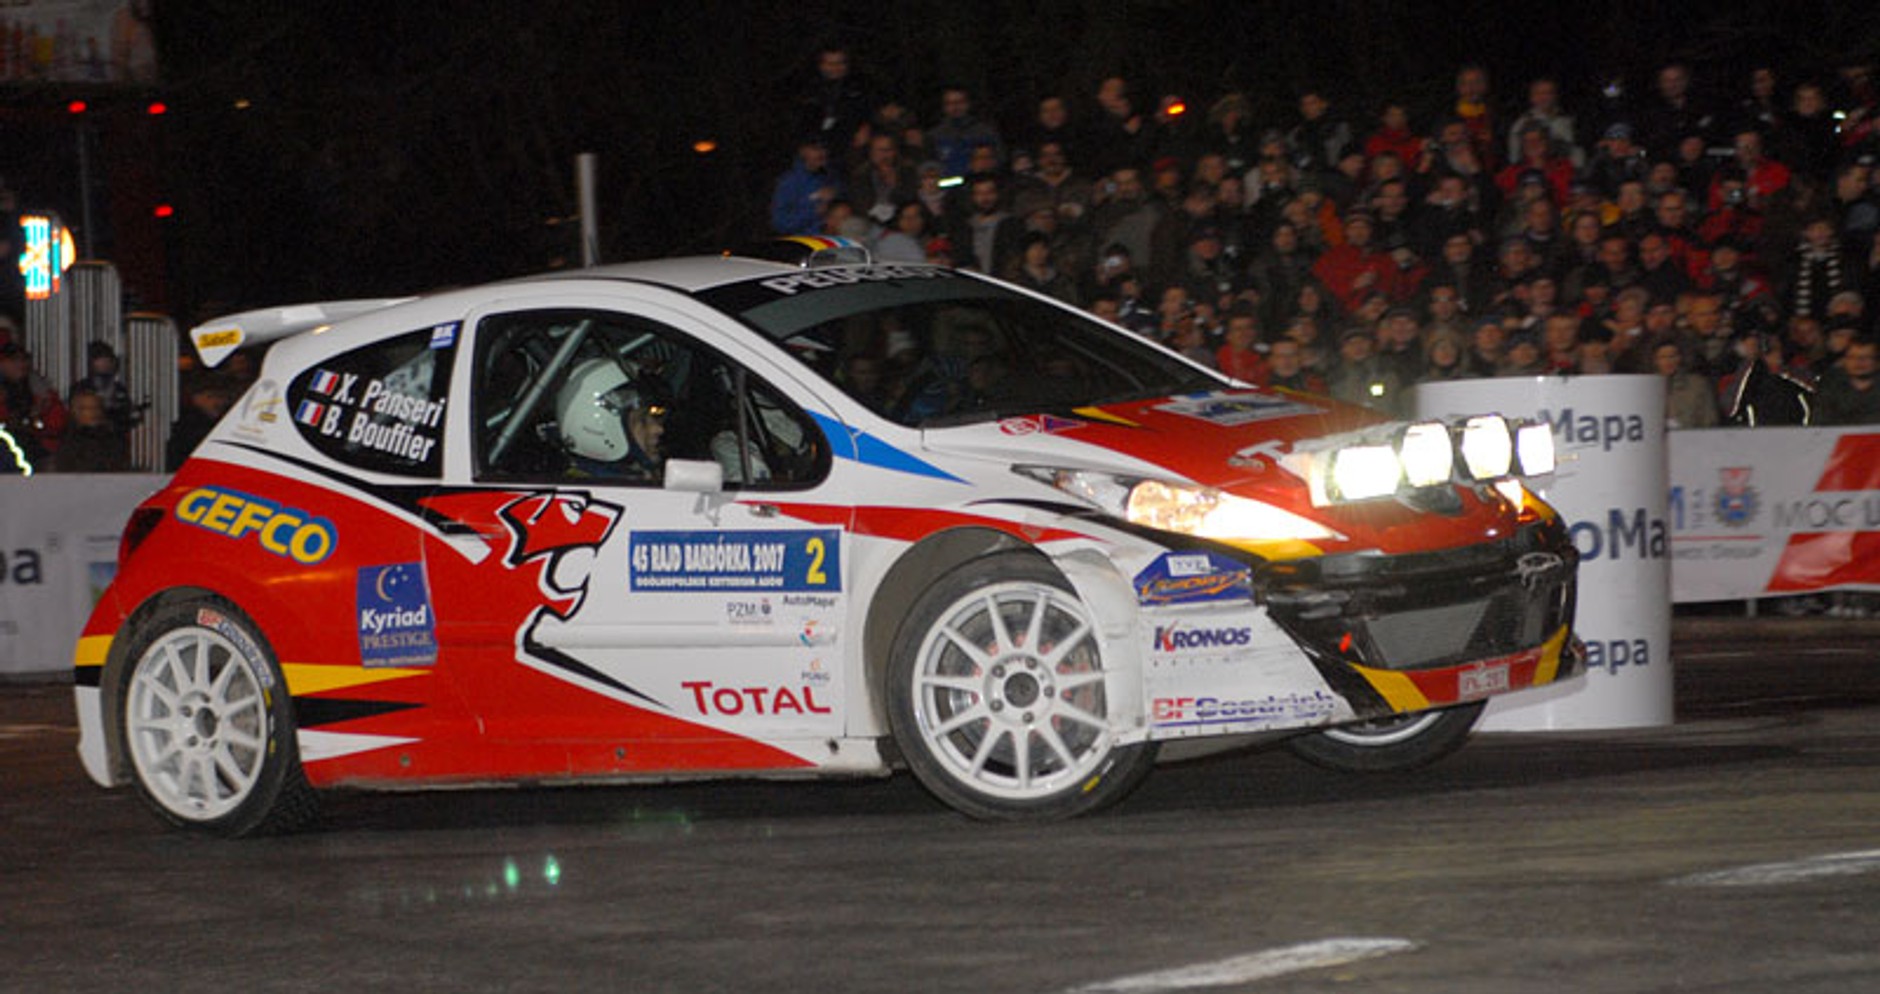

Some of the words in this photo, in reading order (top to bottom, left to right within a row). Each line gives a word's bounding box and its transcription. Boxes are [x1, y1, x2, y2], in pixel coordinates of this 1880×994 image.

[332, 374, 358, 404] X.
[360, 379, 446, 427] Panseri
[321, 404, 342, 438] B.
[349, 411, 435, 462] Bouffier
[176, 488, 333, 563] GEFCO
[632, 543, 649, 573] 45
[651, 543, 682, 572] RAJD
[684, 536, 751, 572] BARBÓRKA
[753, 543, 785, 572] 2007
[805, 538, 825, 584] 2
[361, 604, 427, 633] Kyriad
[1153, 621, 1251, 651] KRONOS
[680, 681, 832, 715] TOTAL
